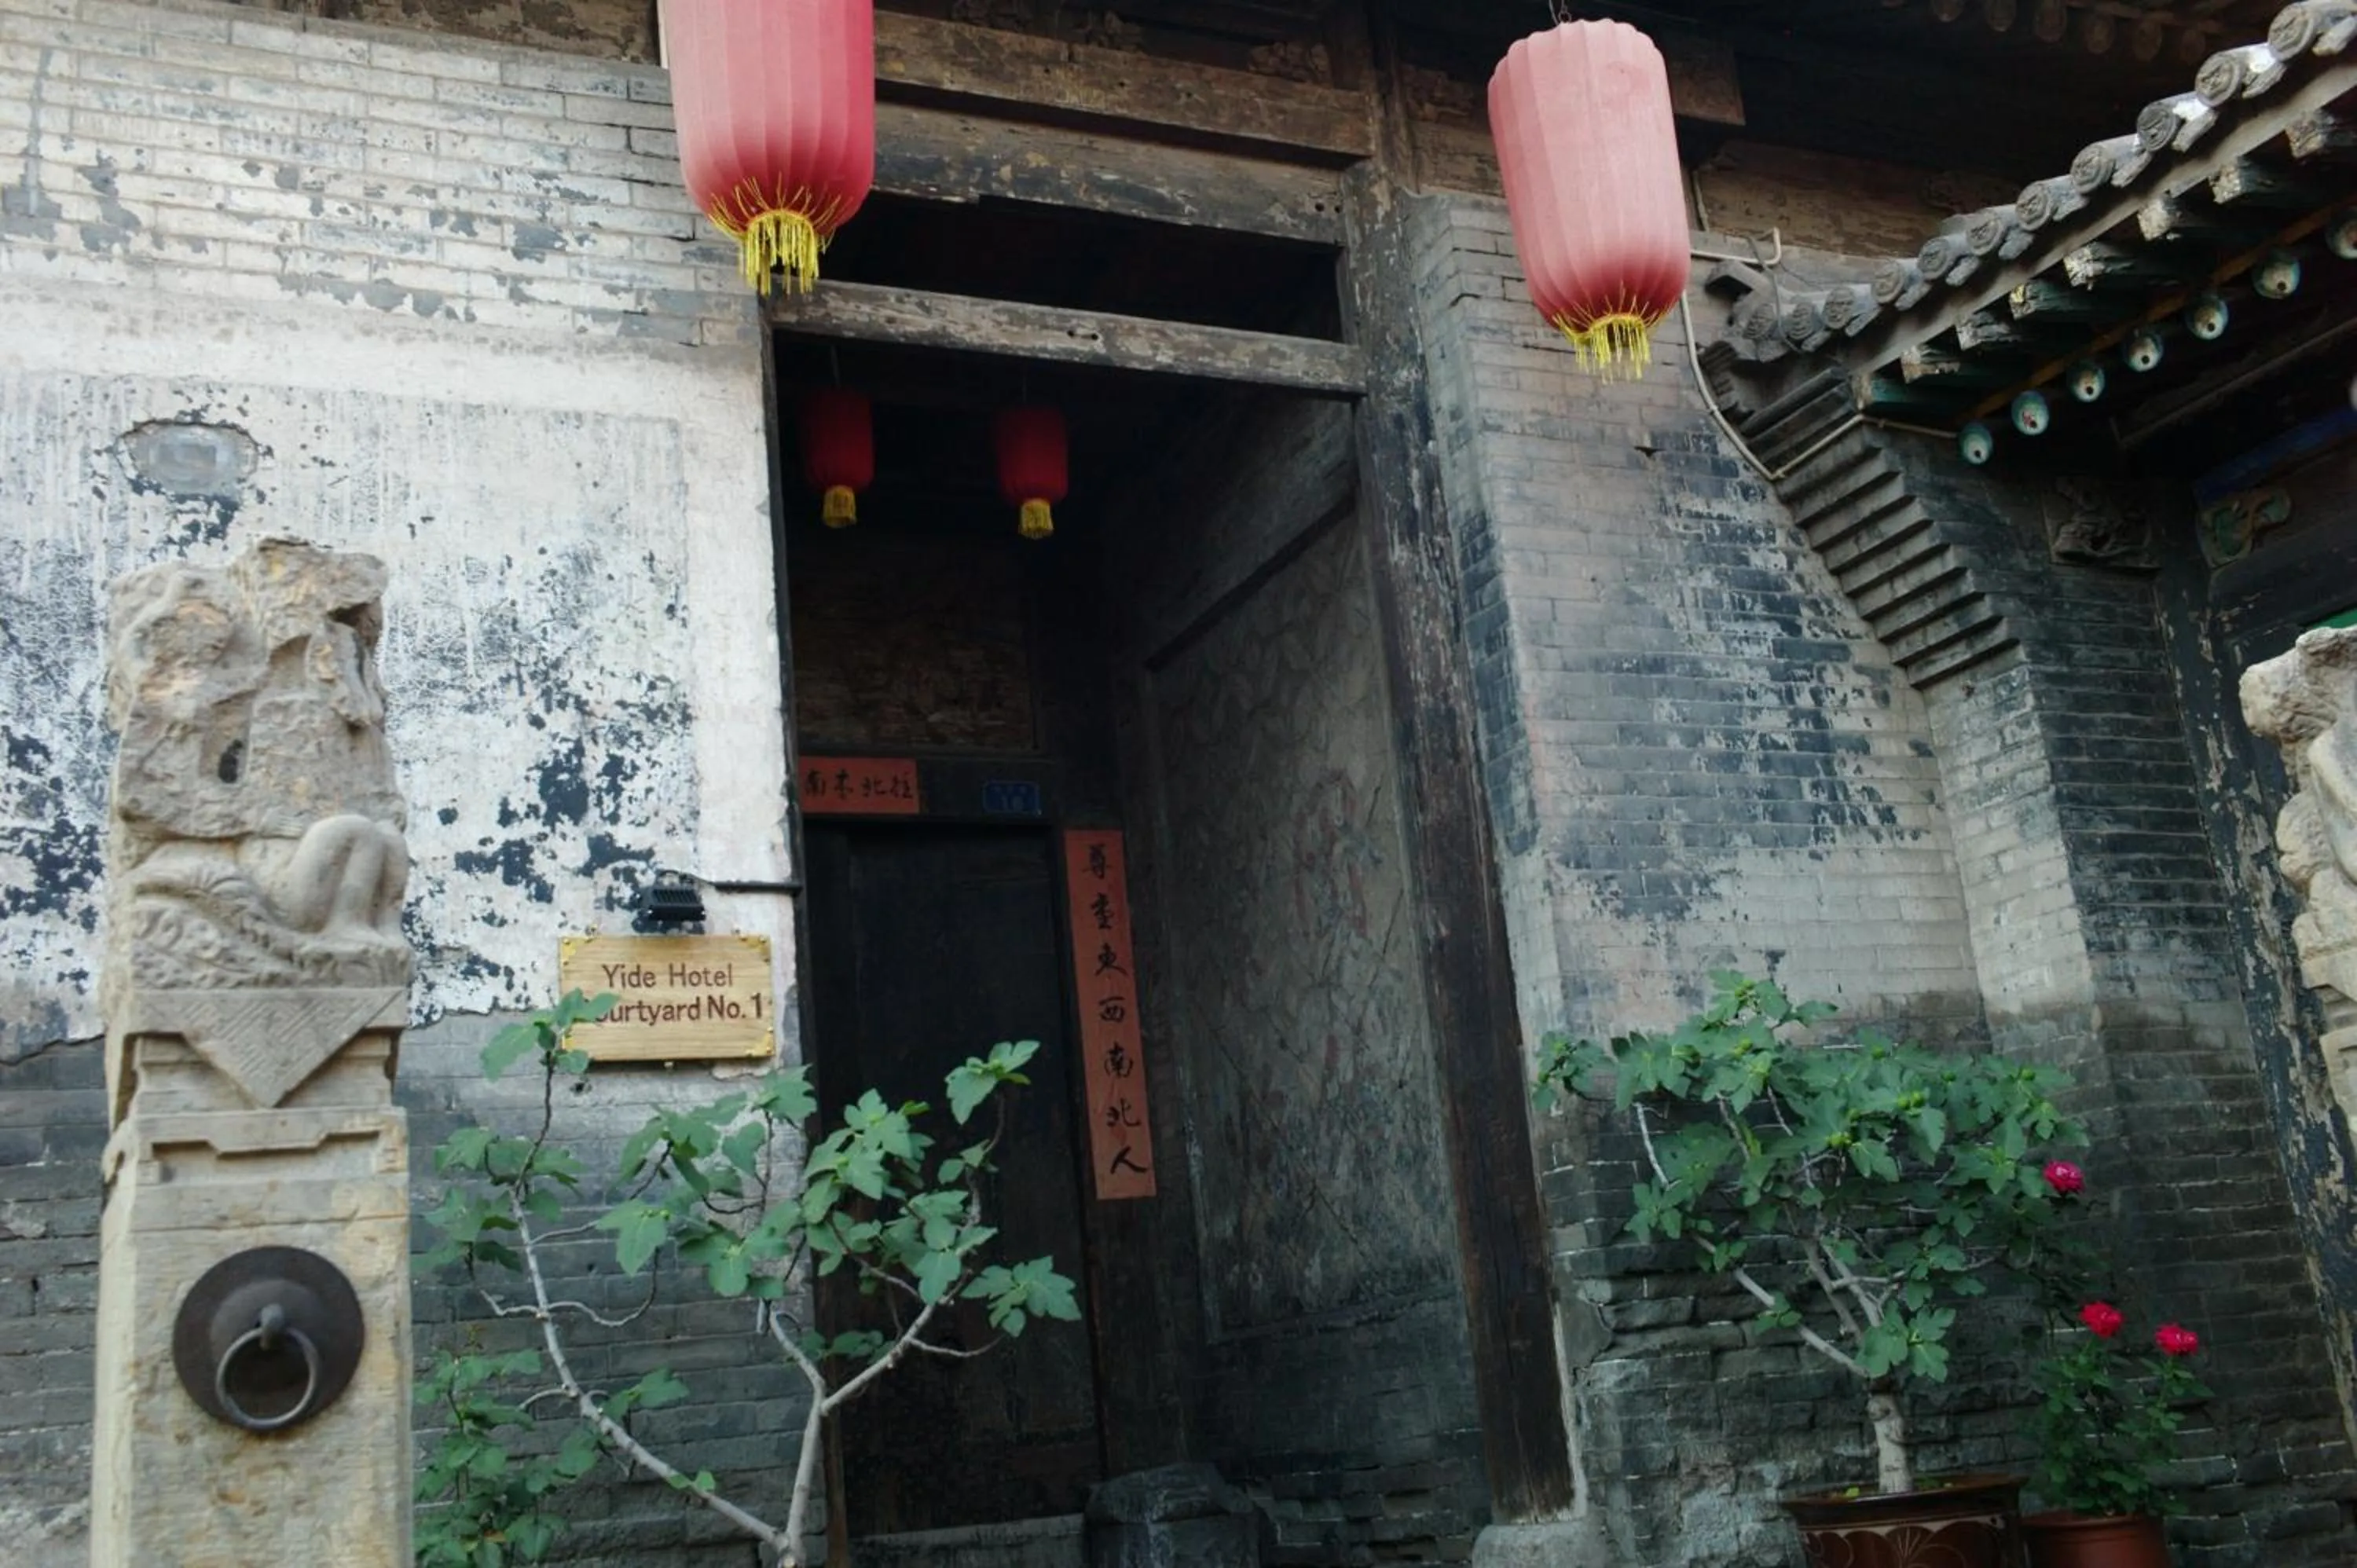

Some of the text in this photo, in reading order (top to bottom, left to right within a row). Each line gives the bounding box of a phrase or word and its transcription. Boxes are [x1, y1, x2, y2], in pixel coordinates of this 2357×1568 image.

[602, 963, 733, 988] Yide Hotel
[585, 995, 701, 1026] urtyard
